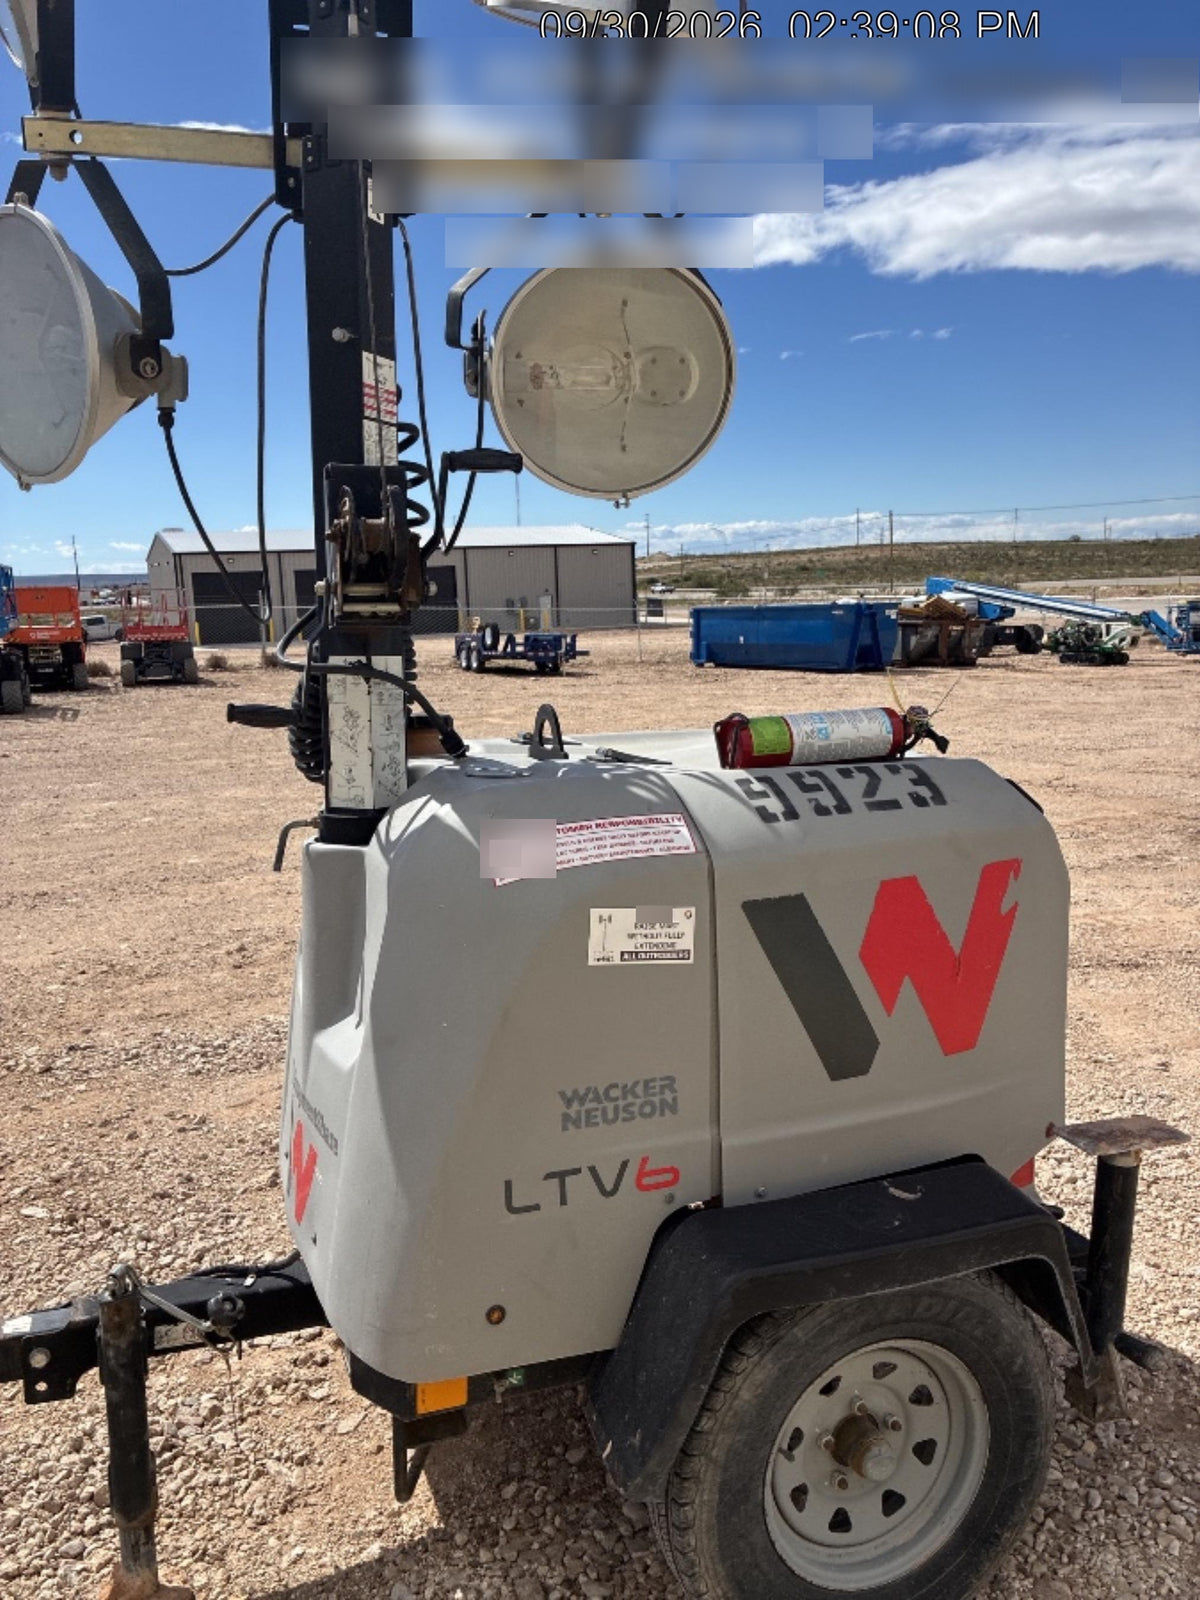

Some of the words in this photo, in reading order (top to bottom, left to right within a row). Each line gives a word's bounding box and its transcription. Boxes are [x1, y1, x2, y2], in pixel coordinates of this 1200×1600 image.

[735, 763, 948, 823] 9923
[637, 951, 689, 959] OUTRS
[558, 1075, 678, 1110] WACKER
[561, 1095, 679, 1131] NEUSON
[504, 1156, 680, 1215] LTV6
